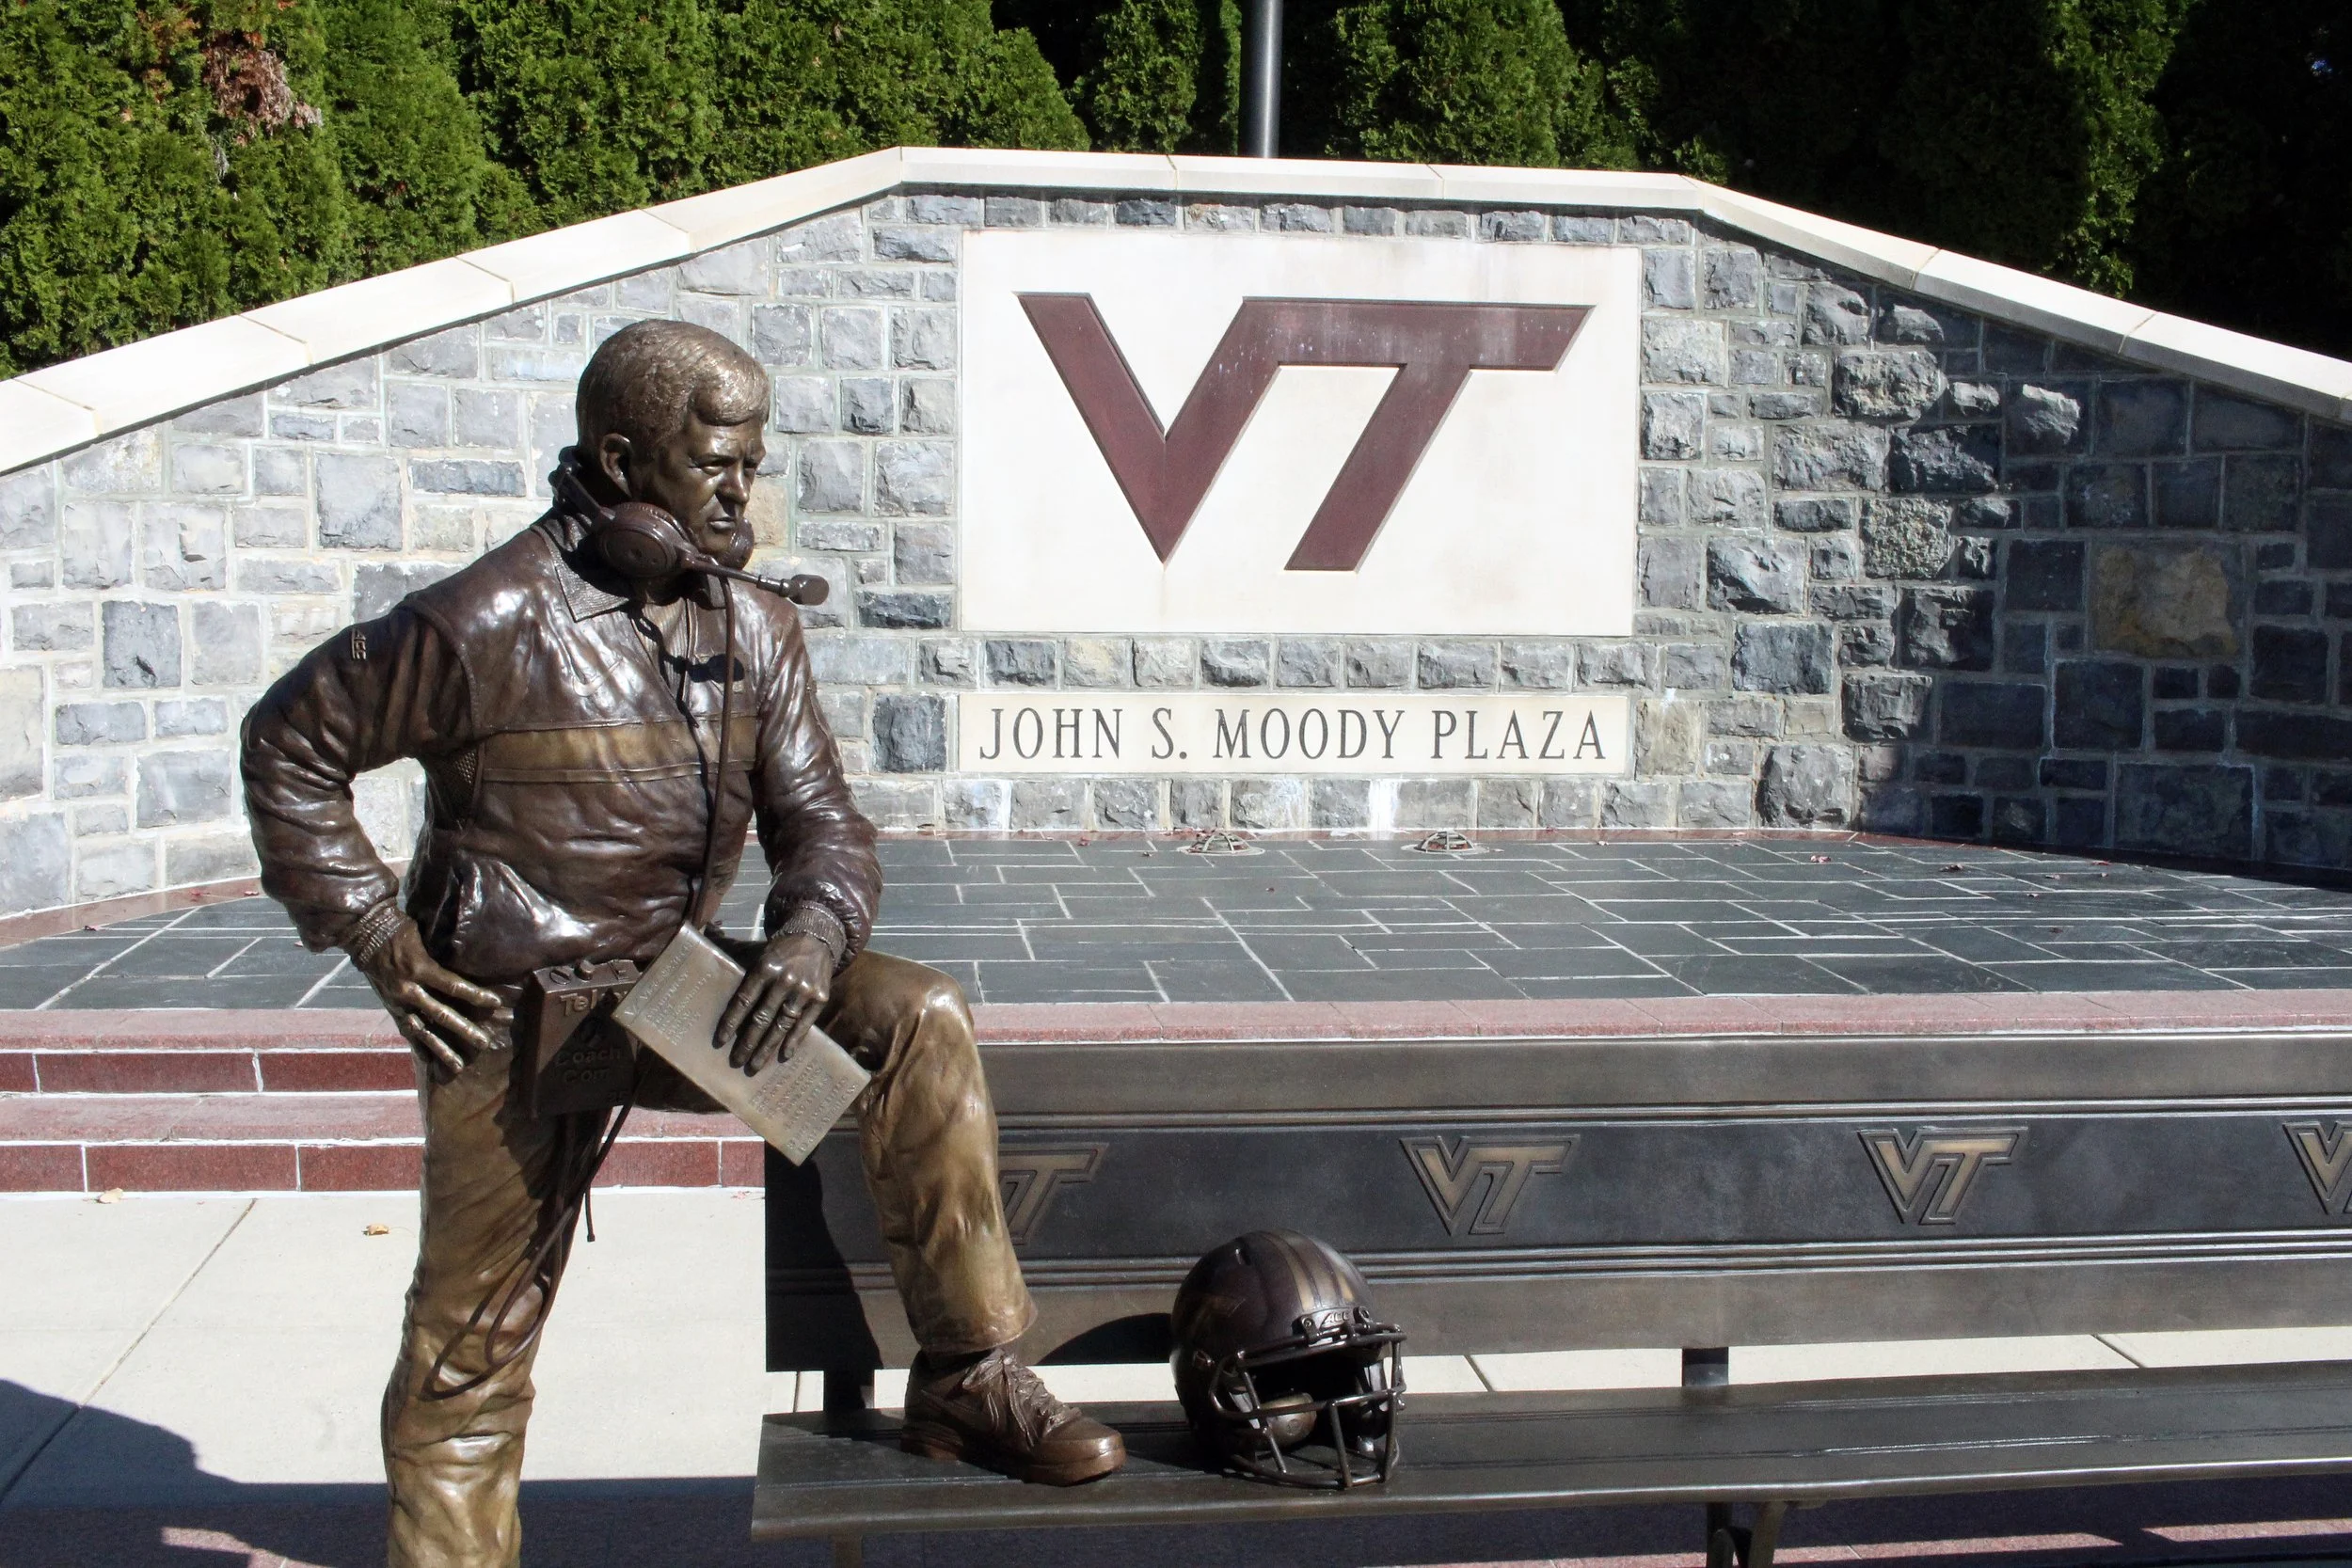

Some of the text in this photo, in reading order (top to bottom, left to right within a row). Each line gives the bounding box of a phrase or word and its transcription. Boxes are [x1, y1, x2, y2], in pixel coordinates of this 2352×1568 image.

[1013, 291, 1597, 575] VT
[979, 707, 1607, 760] JOHN S. MOODY PLAZA
[998, 1142, 1109, 1245] T
[1399, 1133, 1581, 1237] VT
[1857, 1125, 2029, 1225] VT
